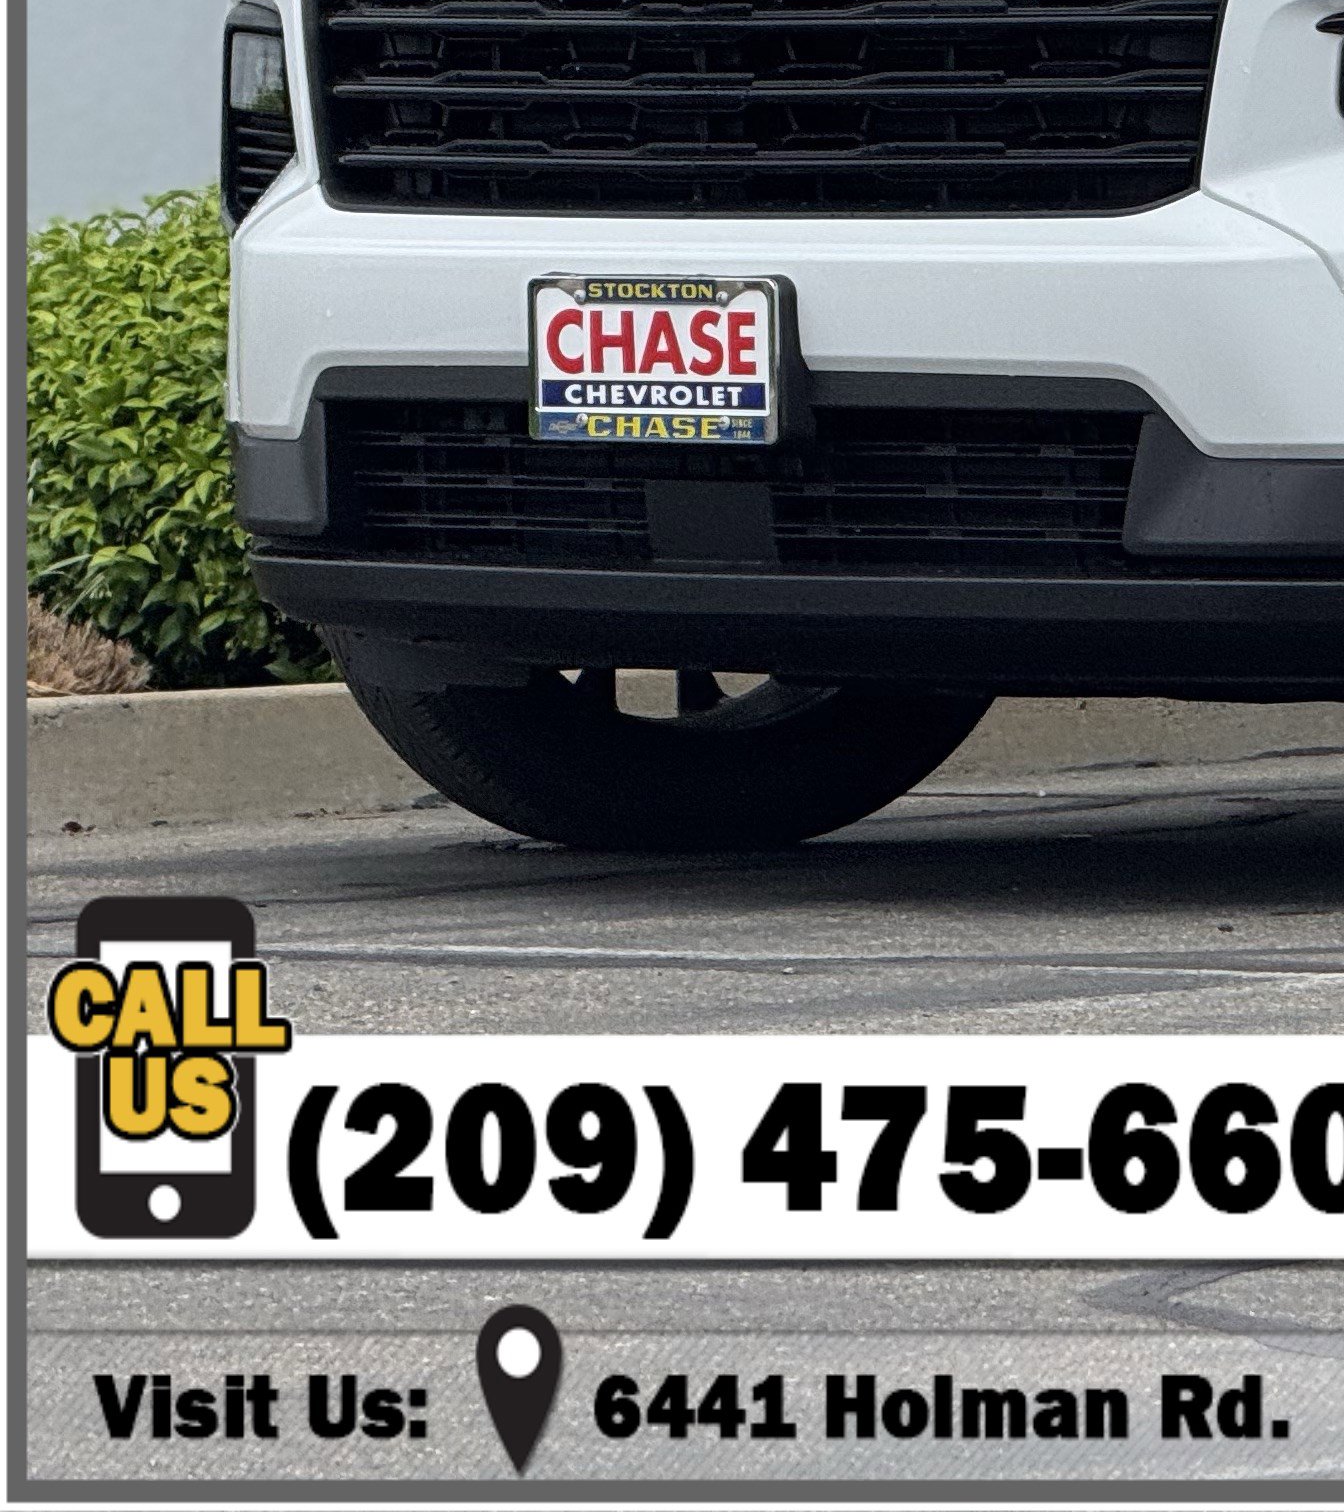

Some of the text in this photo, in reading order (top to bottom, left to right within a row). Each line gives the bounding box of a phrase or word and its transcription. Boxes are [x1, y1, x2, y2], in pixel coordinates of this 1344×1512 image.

[588, 282, 713, 300] STOCKTON
[546, 308, 757, 376] CHASE
[564, 384, 743, 407] CHEVROLET
[587, 415, 722, 439] CHASE
